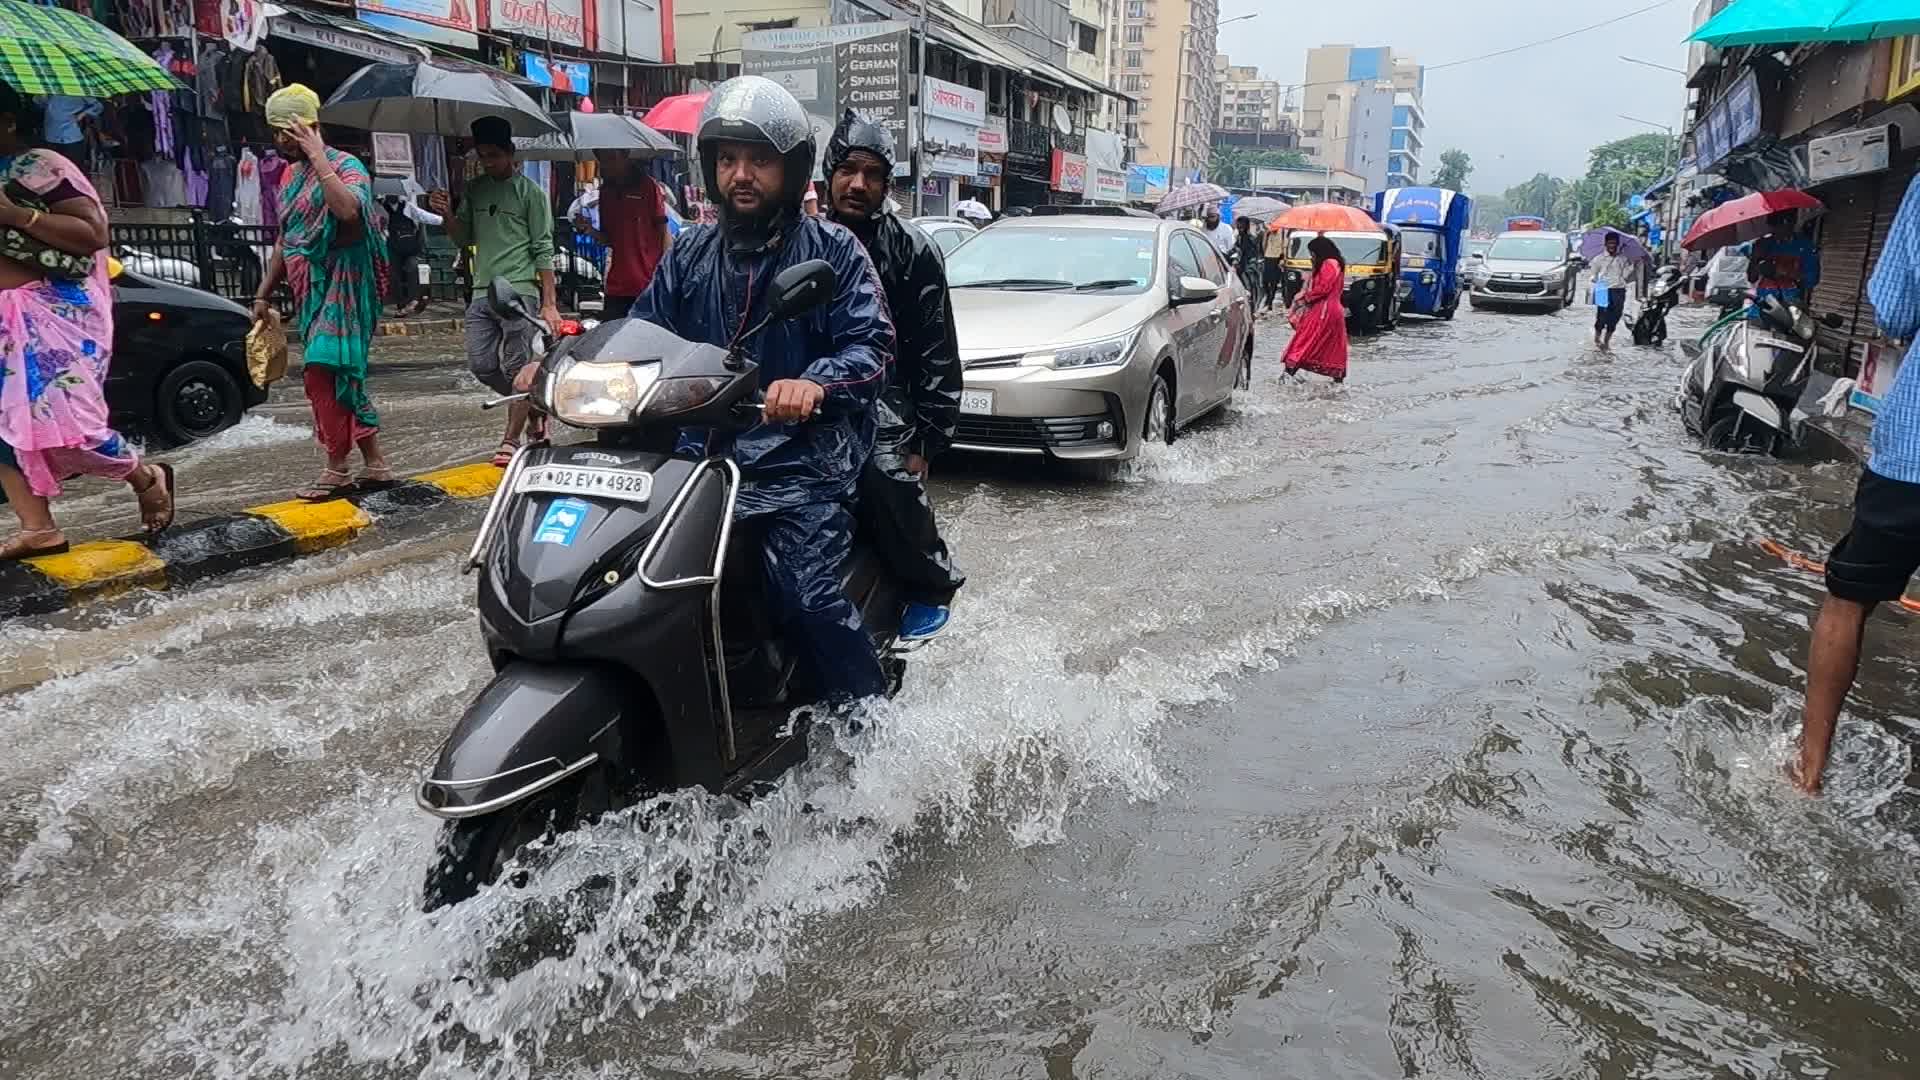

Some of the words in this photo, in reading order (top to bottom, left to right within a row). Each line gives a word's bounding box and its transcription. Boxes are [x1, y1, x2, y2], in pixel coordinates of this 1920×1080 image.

[849, 42, 898, 55] FRENCH
[849, 59, 898, 70] GERMAN
[850, 75, 899, 87] SPANISH
[850, 90, 901, 102] CHINESE
[571, 452, 623, 464] HONDA
[555, 472, 573, 485] 02
[576, 473, 595, 487] EV
[607, 476, 643, 492] 4928
